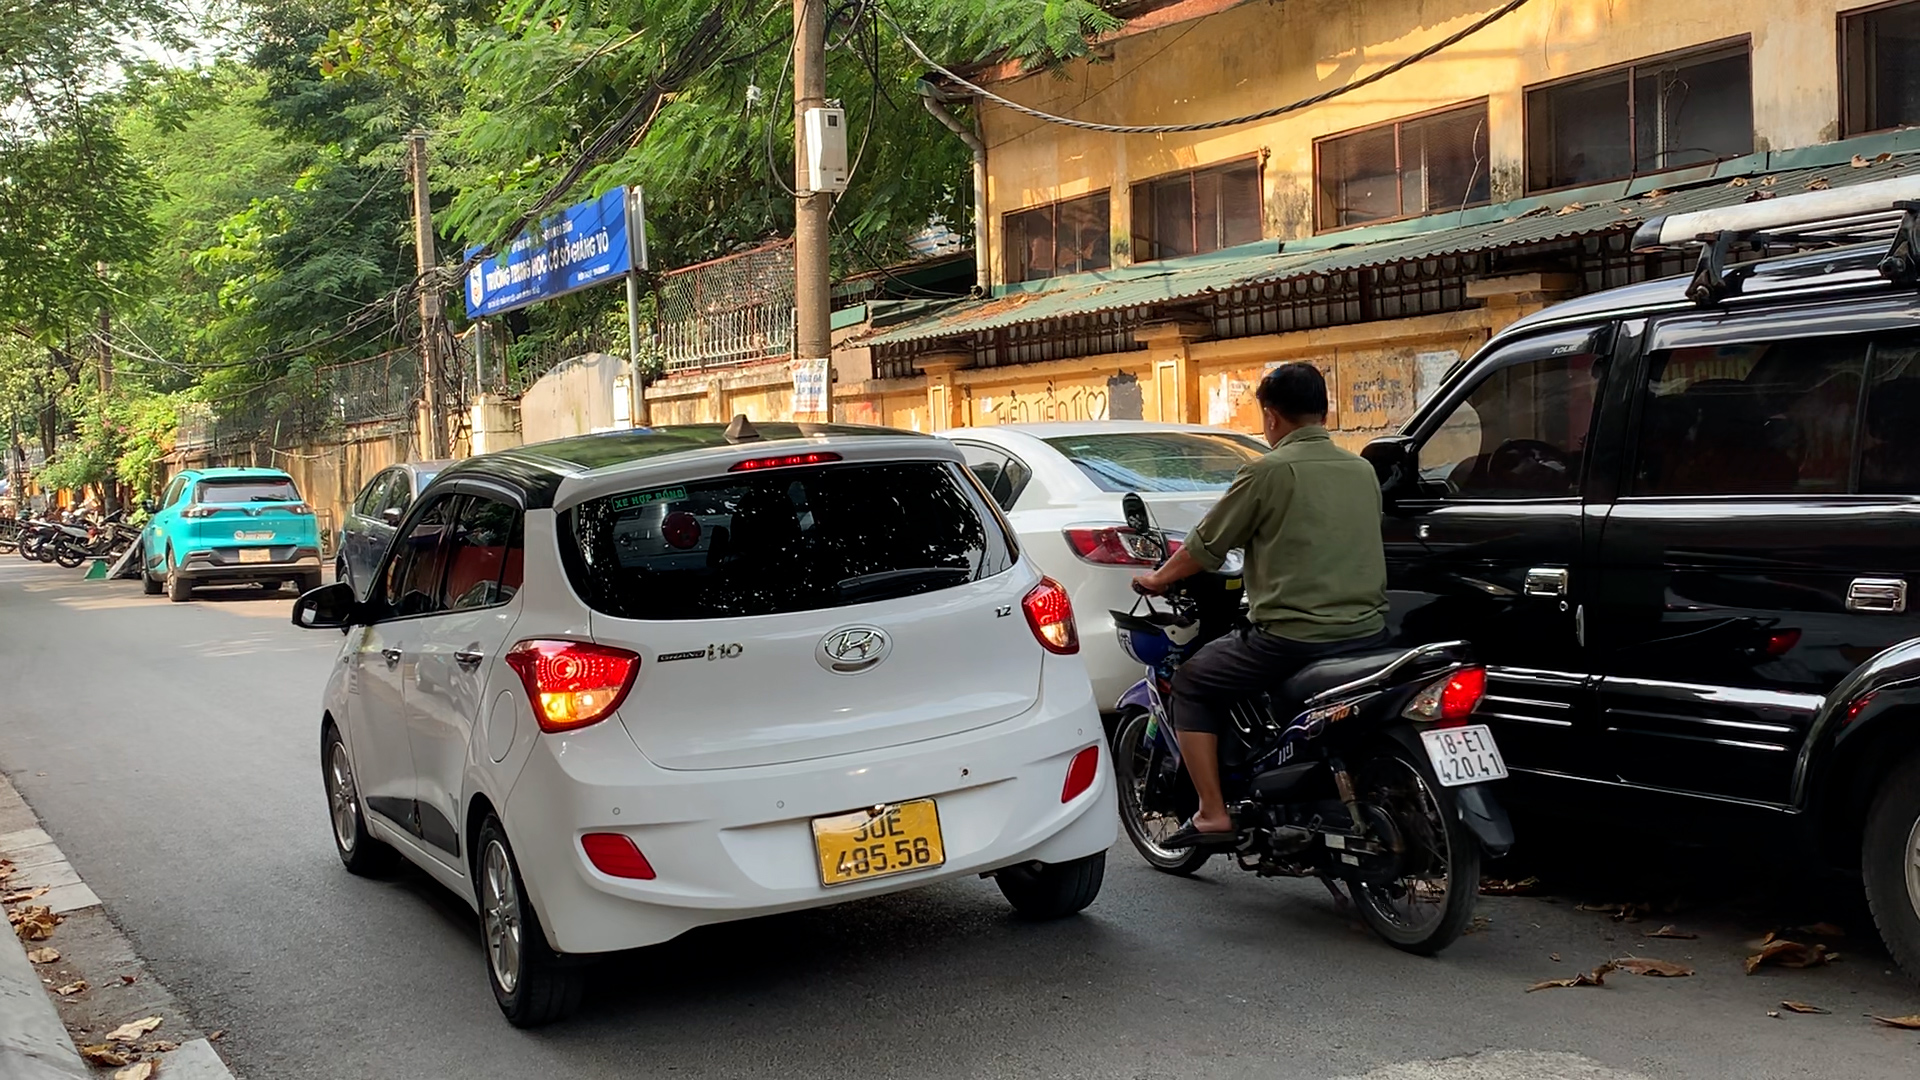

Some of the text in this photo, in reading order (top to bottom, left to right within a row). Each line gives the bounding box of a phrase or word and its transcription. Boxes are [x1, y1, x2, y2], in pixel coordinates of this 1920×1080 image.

[531, 253, 548, 281] HỌC
[614, 498, 629, 509] XE
[1435, 730, 1485, 755] 18-E1
[1439, 752, 1501, 781] 420.41
